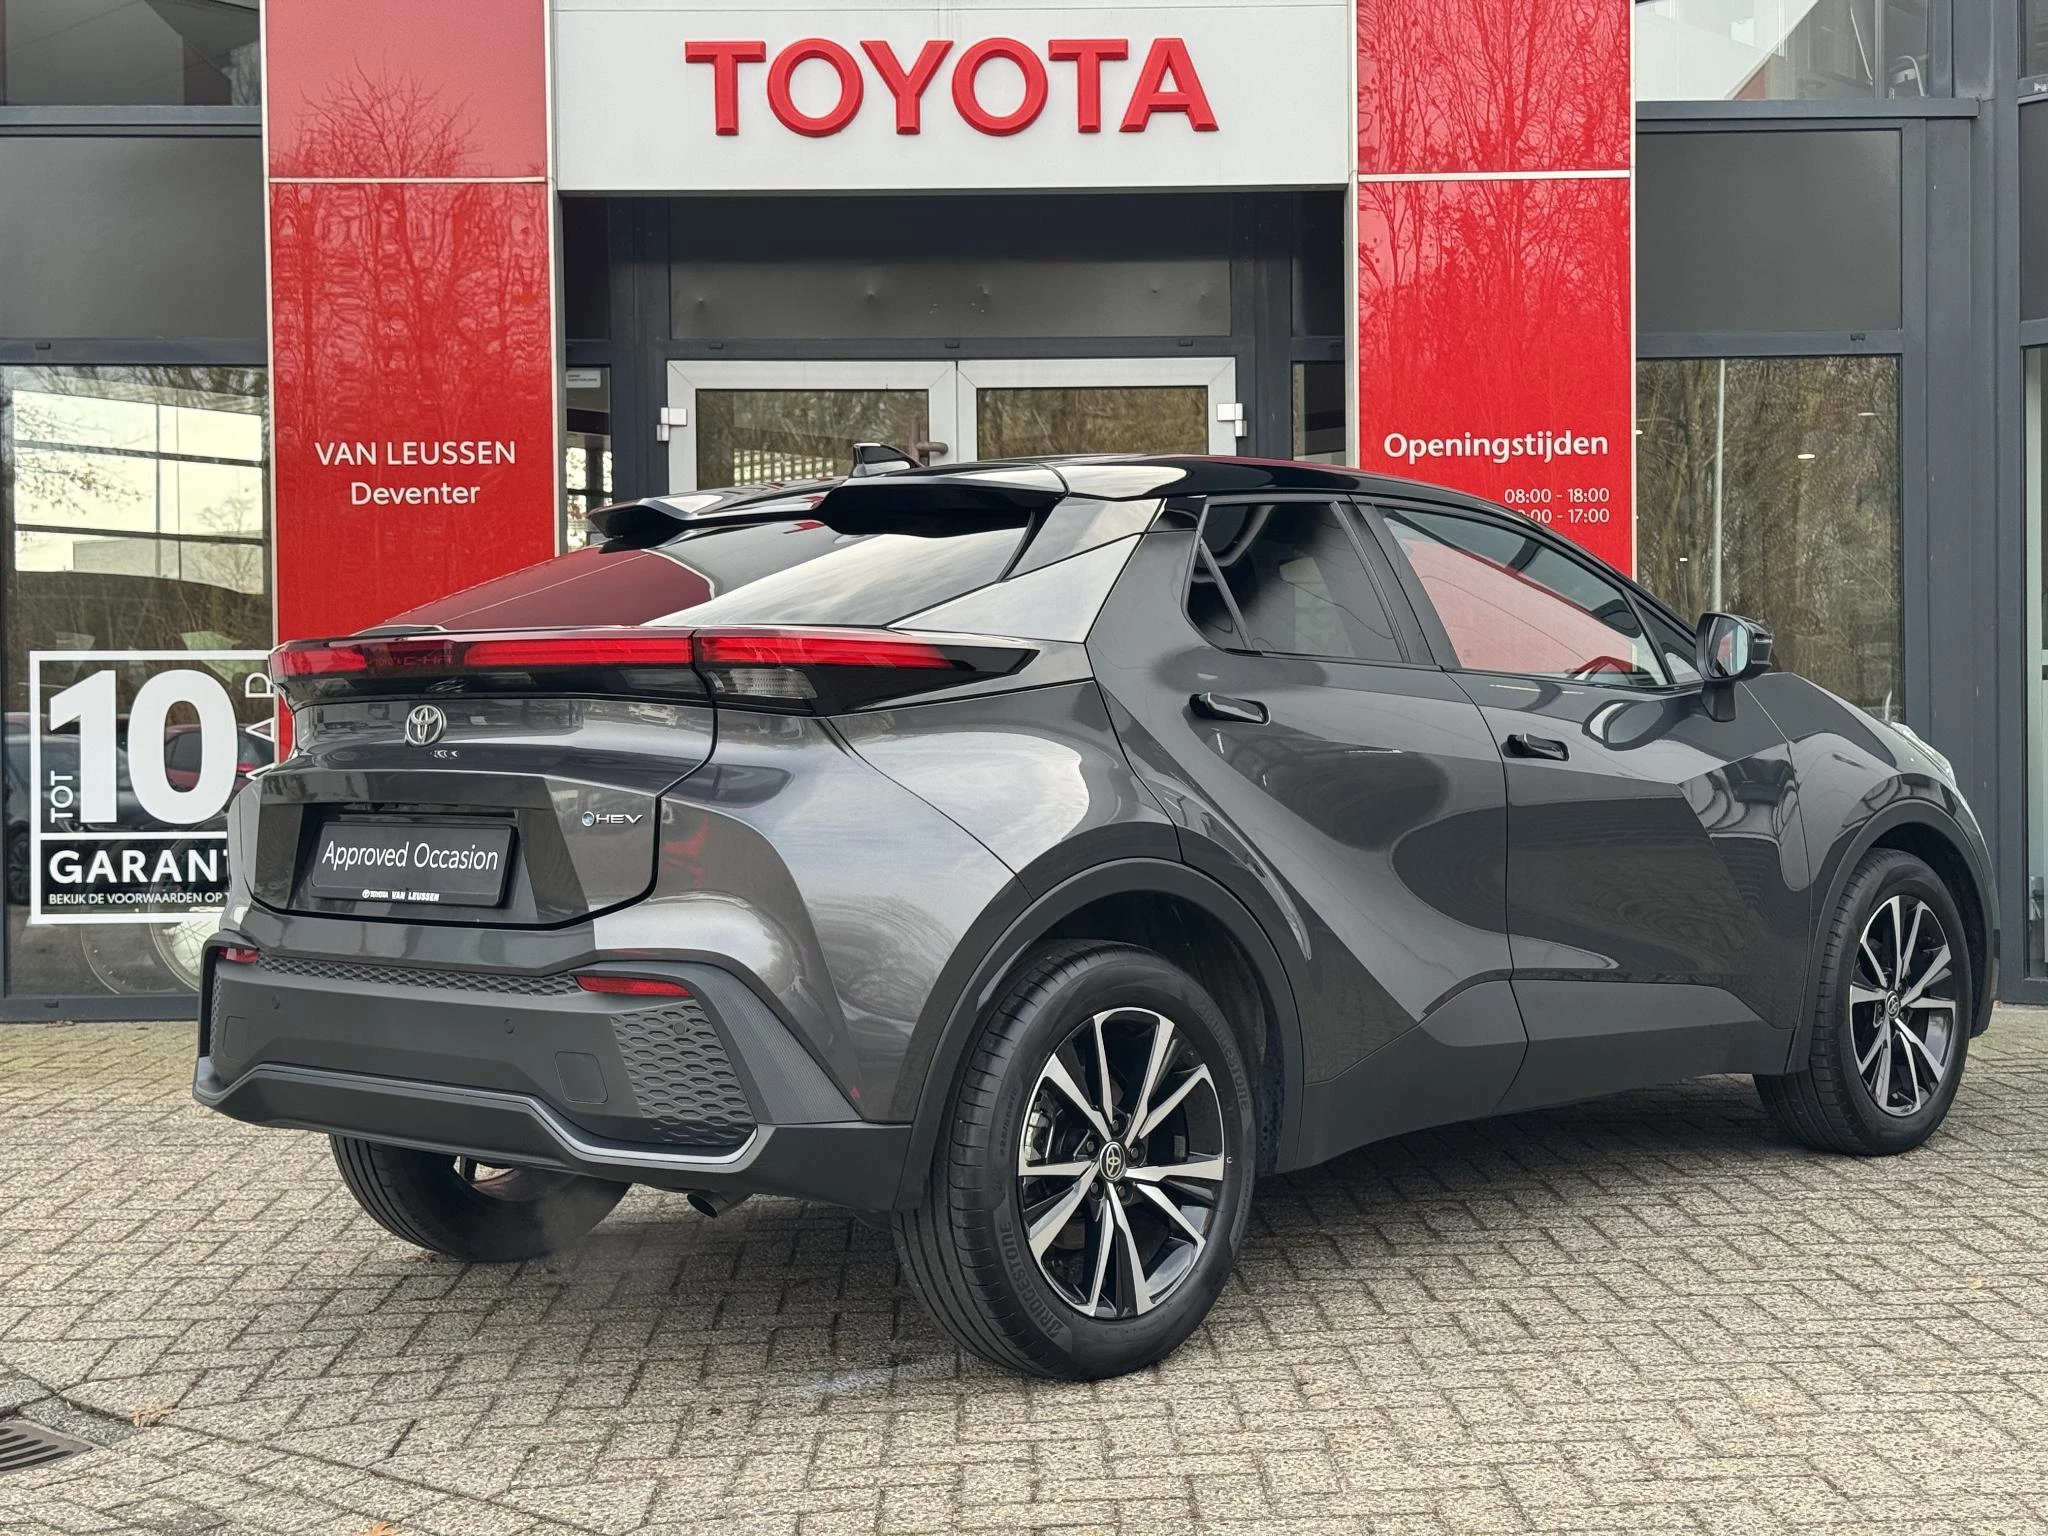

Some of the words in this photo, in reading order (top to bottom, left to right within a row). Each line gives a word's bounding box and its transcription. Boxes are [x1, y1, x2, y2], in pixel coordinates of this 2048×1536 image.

[685, 37, 1219, 137] TOYOTA
[314, 442, 377, 466] VAN
[387, 441, 515, 465] LEUSSEN
[1383, 430, 1608, 465] Openingstijden
[351, 481, 481, 505] Deventer
[1504, 488, 1552, 504] 08:00
[1567, 487, 1610, 503] 18:00
[1567, 508, 1610, 524] 17:00
[50, 669, 238, 824] 10
[50, 770, 74, 823] TOT
[596, 814, 643, 824] HEV
[49, 849, 228, 884] GARAN
[322, 841, 410, 871] Approved
[414, 842, 499, 871] Occasion
[49, 893, 87, 905] BEKIJK
[88, 893, 105, 904] DE
[106, 892, 202, 904] VOORWAARDEN
[204, 891, 223, 903] OP
[391, 891, 406, 900] VAN
[407, 891, 440, 902] LEUSSEN
[999, 1220, 1065, 1340] BRIDGESTONE
